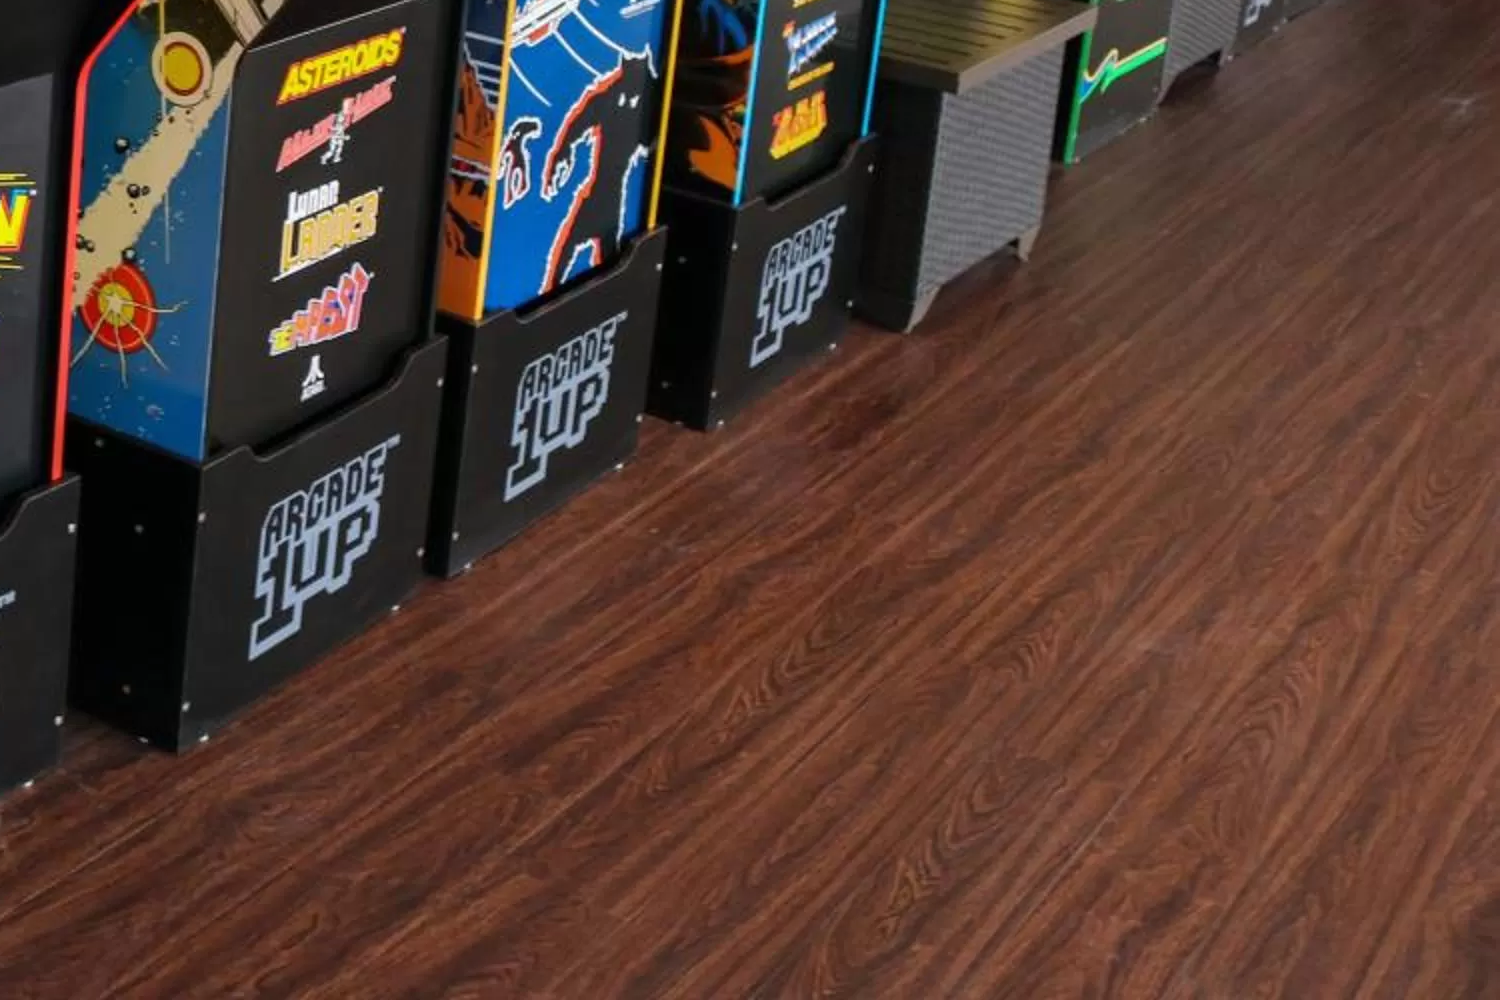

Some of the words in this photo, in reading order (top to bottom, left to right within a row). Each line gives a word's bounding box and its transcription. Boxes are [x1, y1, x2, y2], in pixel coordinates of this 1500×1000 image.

[276, 29, 402, 106] ASTEROIDS
[762, 209, 839, 288] ARCADE
[516, 316, 617, 415] ARCADE
[749, 255, 832, 368] 1UP
[504, 364, 610, 502] 1UP
[261, 442, 387, 559] ARCADE
[248, 500, 380, 661] 1UP
